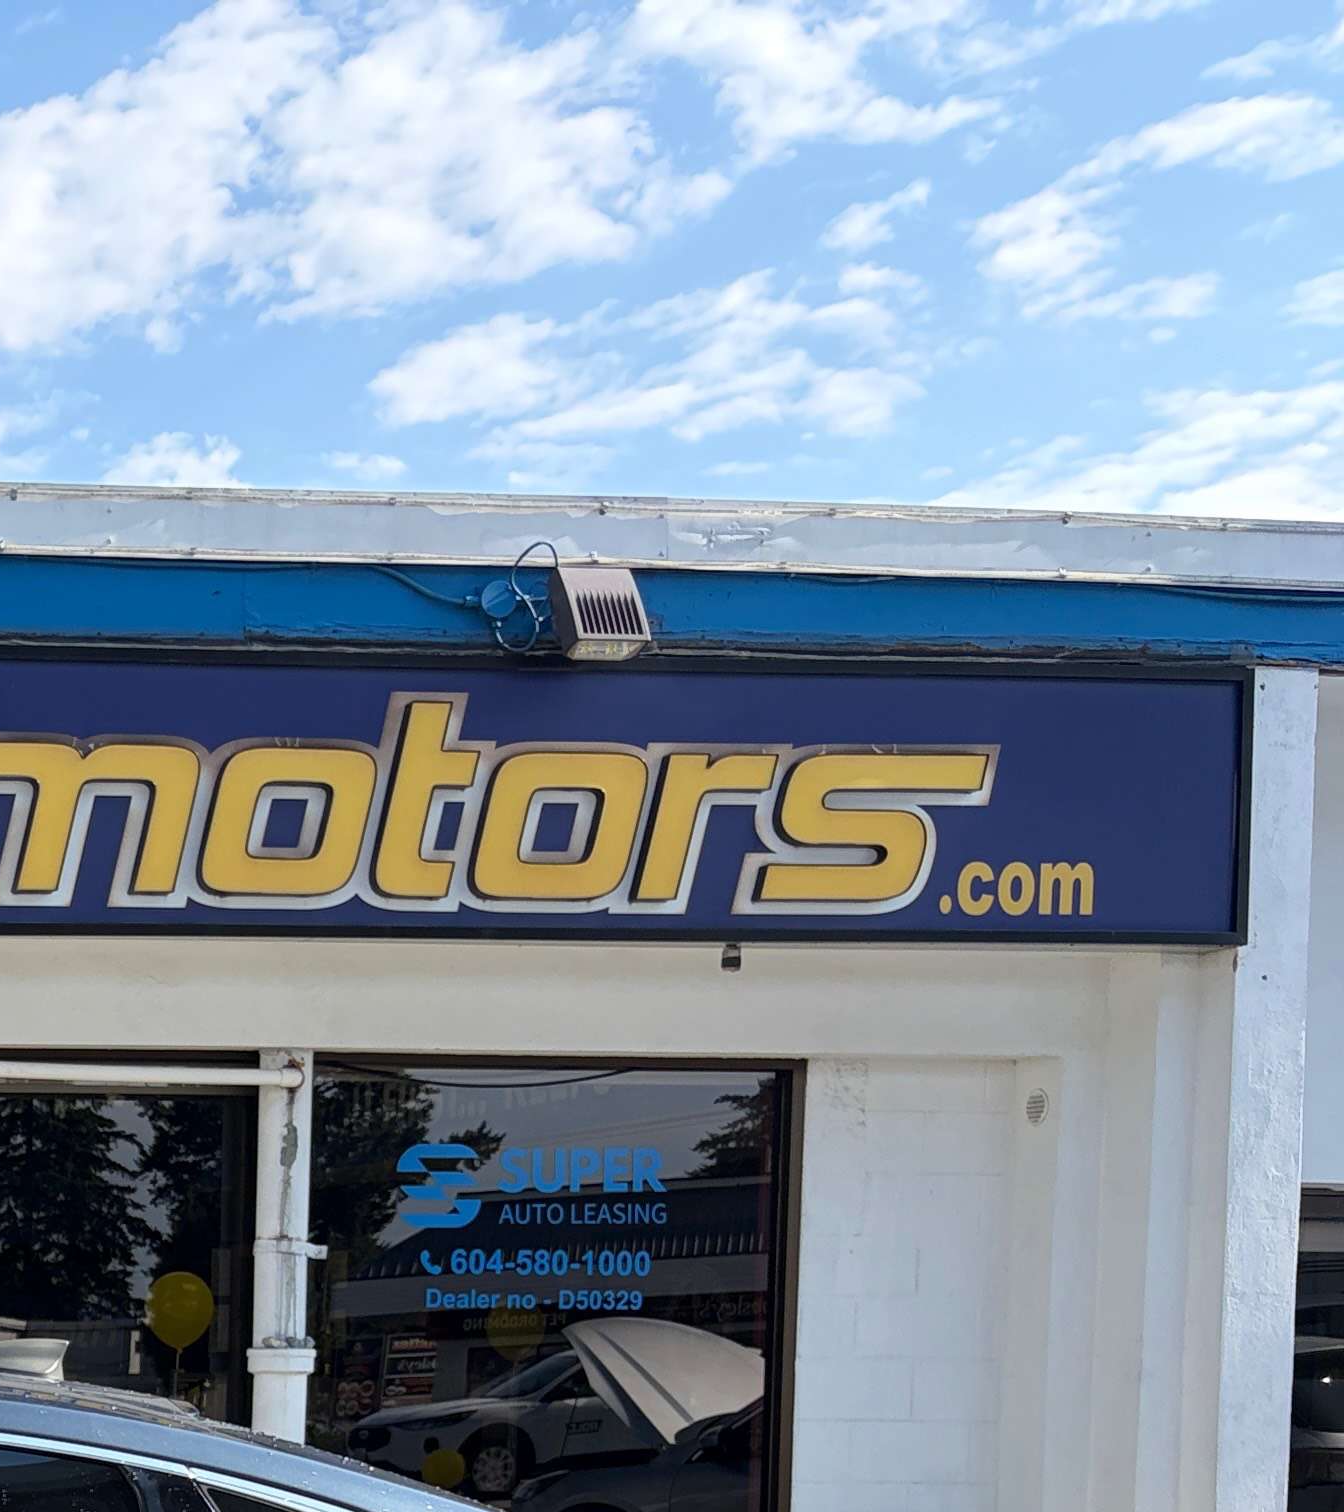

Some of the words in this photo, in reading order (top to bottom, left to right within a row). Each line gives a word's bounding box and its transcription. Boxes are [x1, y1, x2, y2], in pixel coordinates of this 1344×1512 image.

[497, 1145, 668, 1194] SUPER
[499, 1203, 565, 1226] AUTO
[570, 1203, 667, 1226] LEASING
[449, 1248, 652, 1278] 604-580-1000
[425, 1288, 502, 1310] Dealer
[506, 1293, 537, 1311] no
[557, 1289, 643, 1312] D50329
